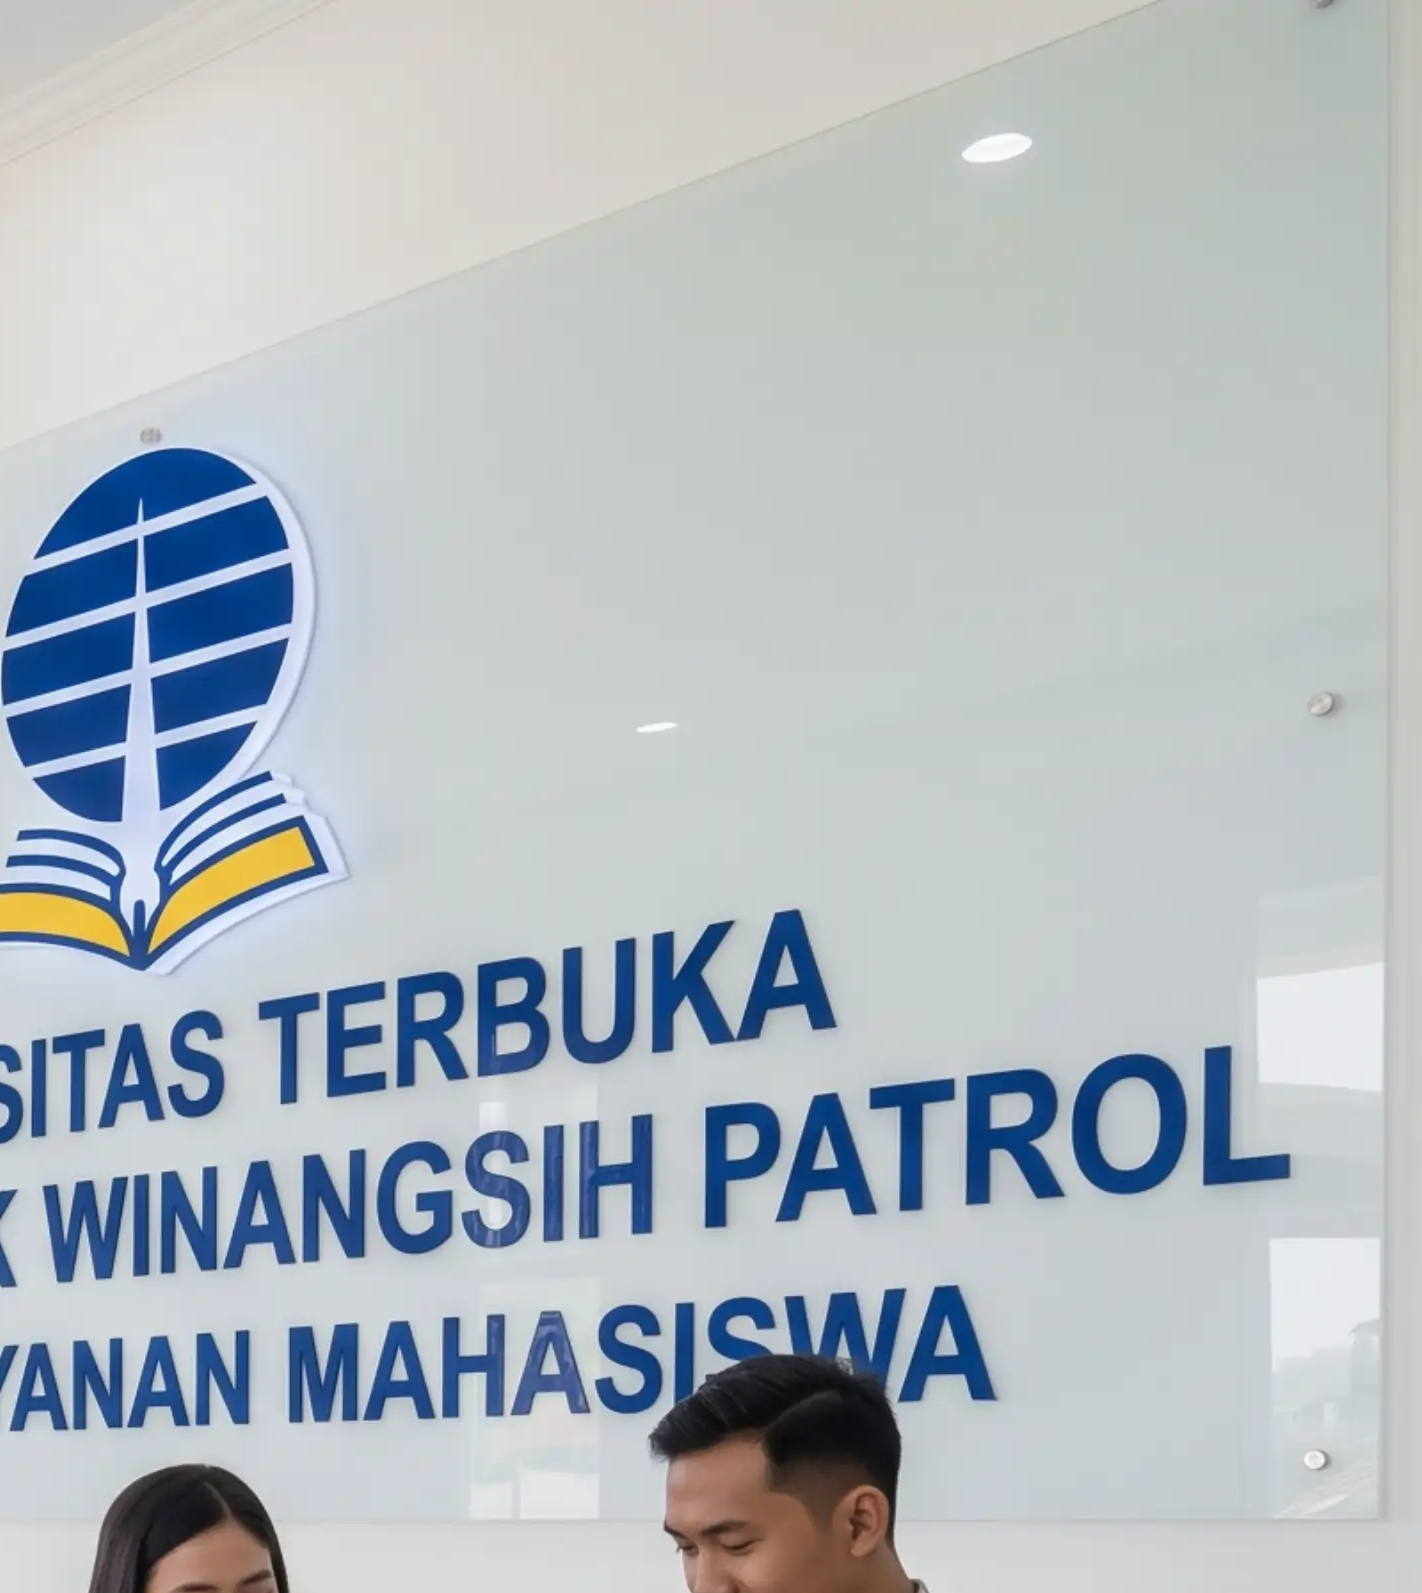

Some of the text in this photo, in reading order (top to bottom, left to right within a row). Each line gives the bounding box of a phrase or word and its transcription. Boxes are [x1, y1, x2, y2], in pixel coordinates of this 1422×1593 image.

[258, 910, 837, 1106] TERBUKA
[43, 1114, 654, 1284] WINANGSIH
[703, 1047, 1292, 1230] PATROL
[287, 1286, 998, 1424] MAHASISWA
